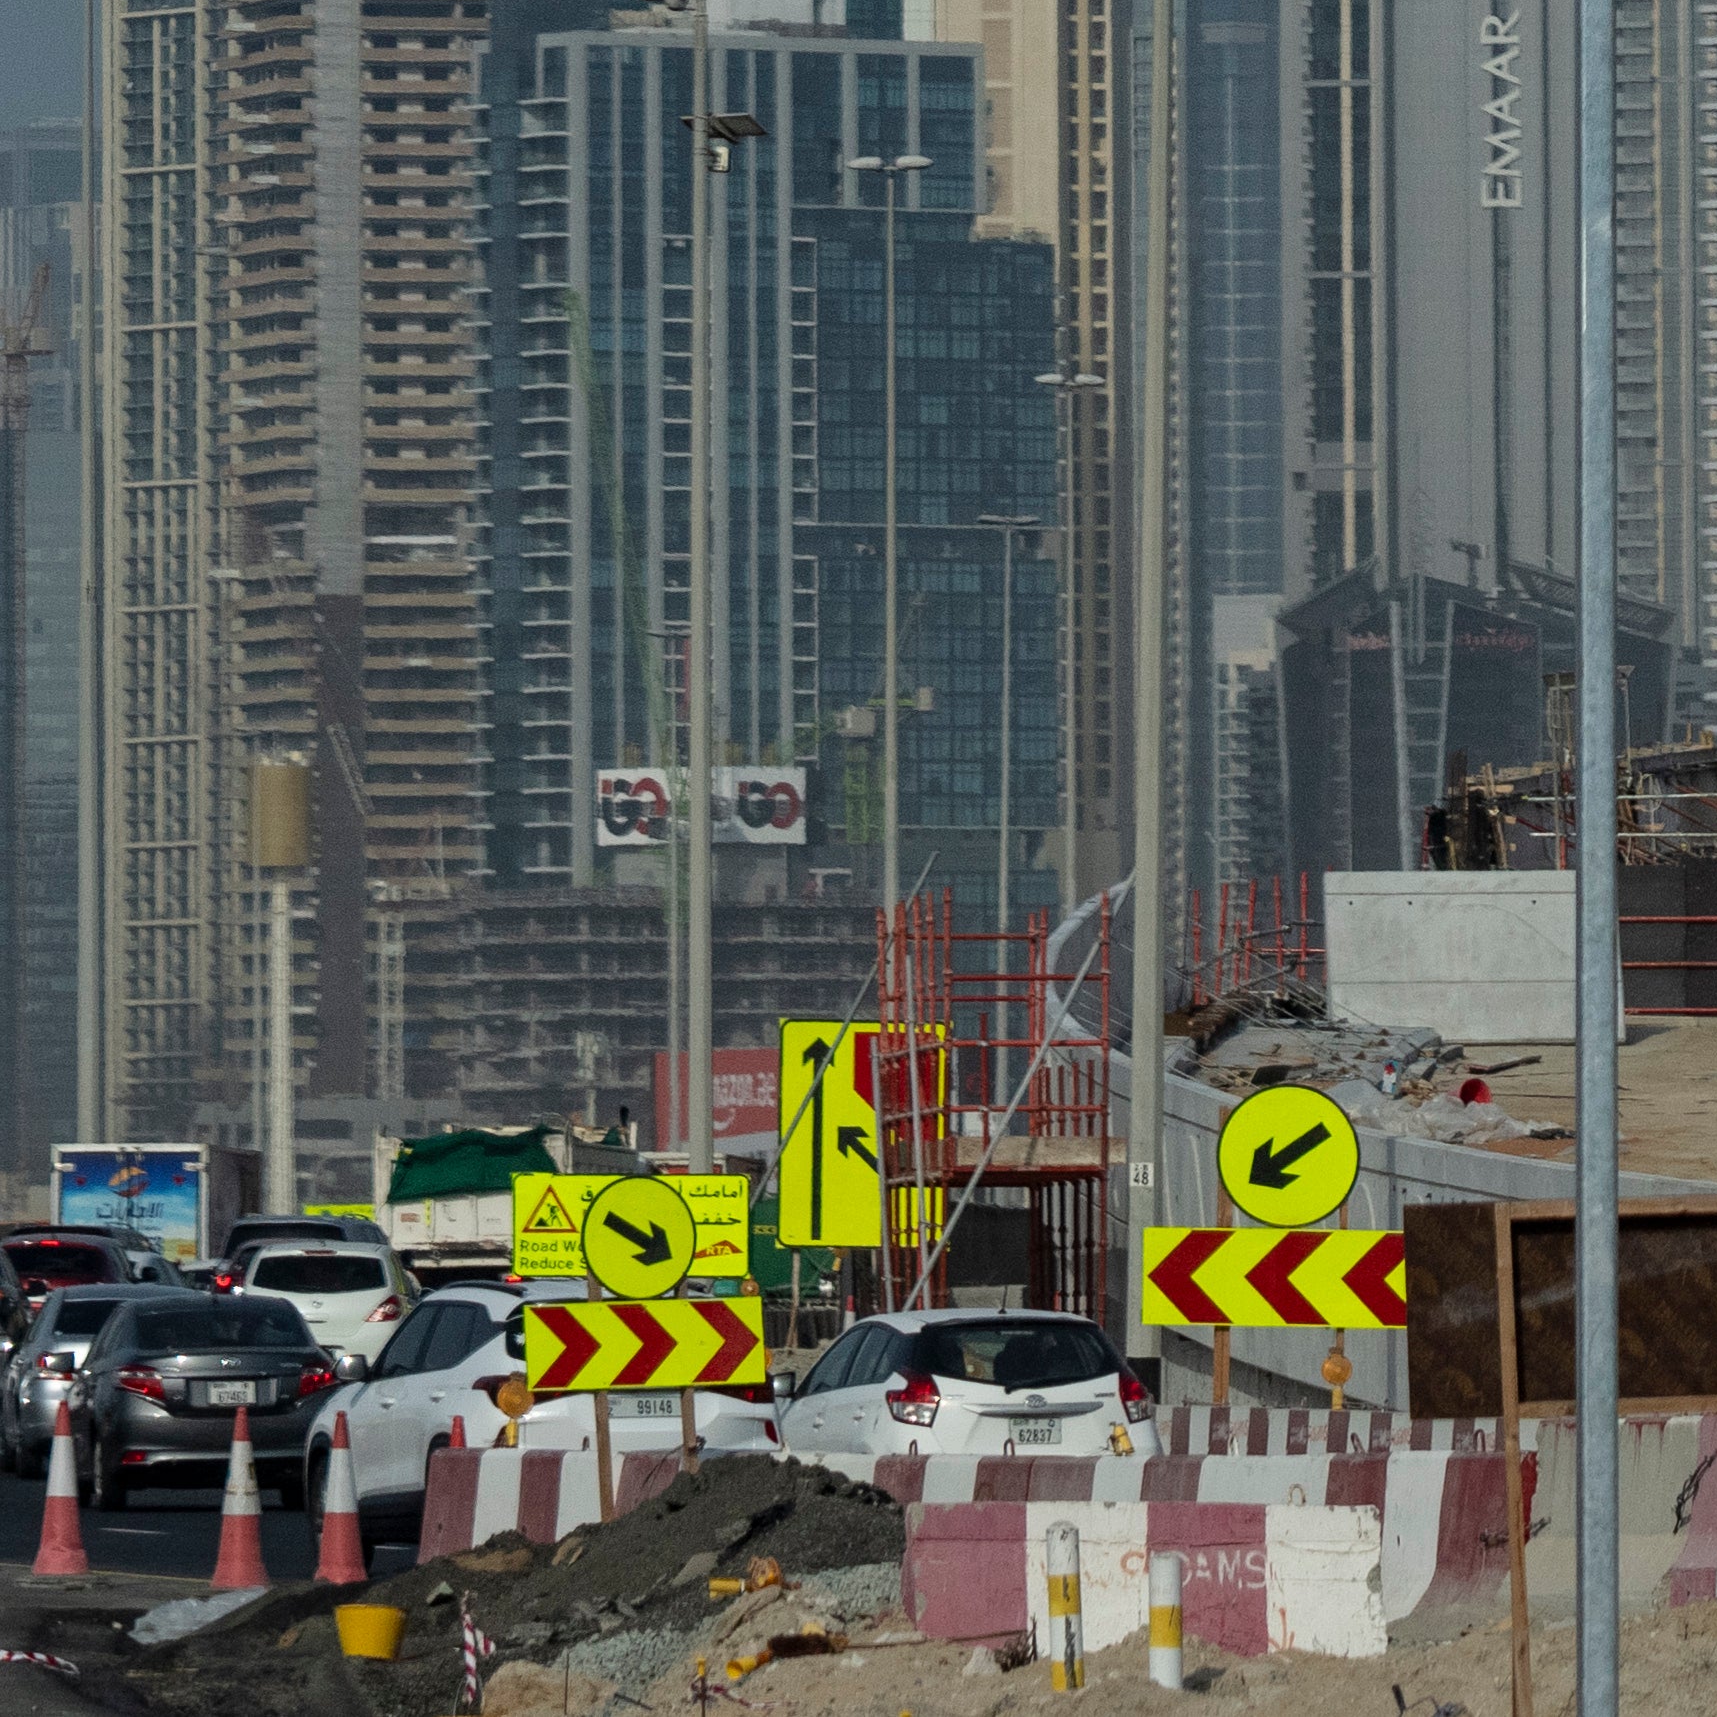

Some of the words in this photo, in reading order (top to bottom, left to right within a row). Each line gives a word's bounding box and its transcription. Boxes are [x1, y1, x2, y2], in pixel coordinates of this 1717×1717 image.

[1480, 9, 1523, 208] EMAAR
[1133, 1171, 1149, 1185] 48
[520, 1239, 558, 1252] Road
[520, 1256, 574, 1270] Reduce
[636, 1400, 673, 1414] 99148
